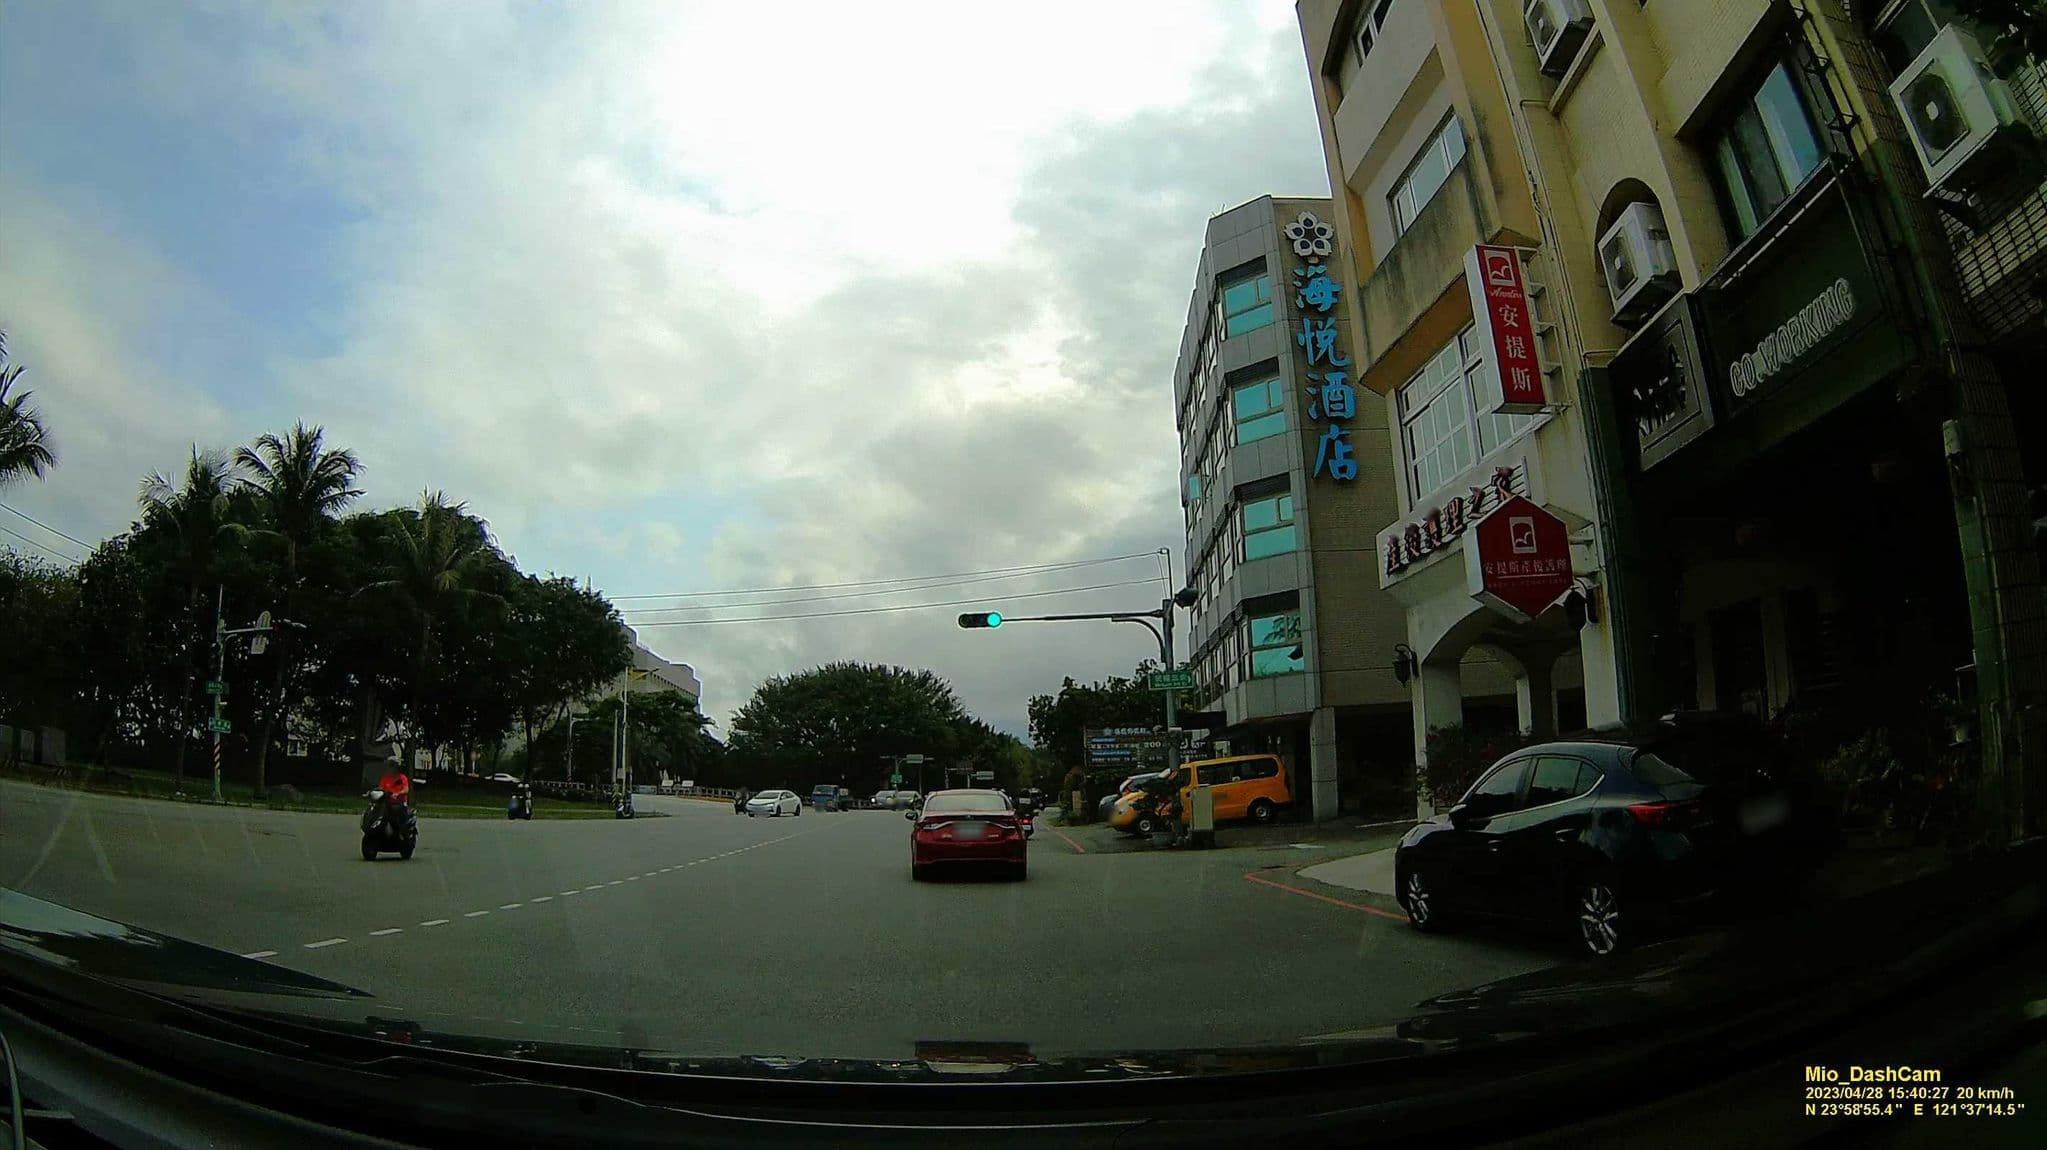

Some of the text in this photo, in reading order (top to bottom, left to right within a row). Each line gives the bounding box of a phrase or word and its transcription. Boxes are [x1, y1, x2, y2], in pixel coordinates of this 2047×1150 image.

[1293, 265, 1358, 481] 海悅酒店
[1498, 303, 1532, 392] 安提斯
